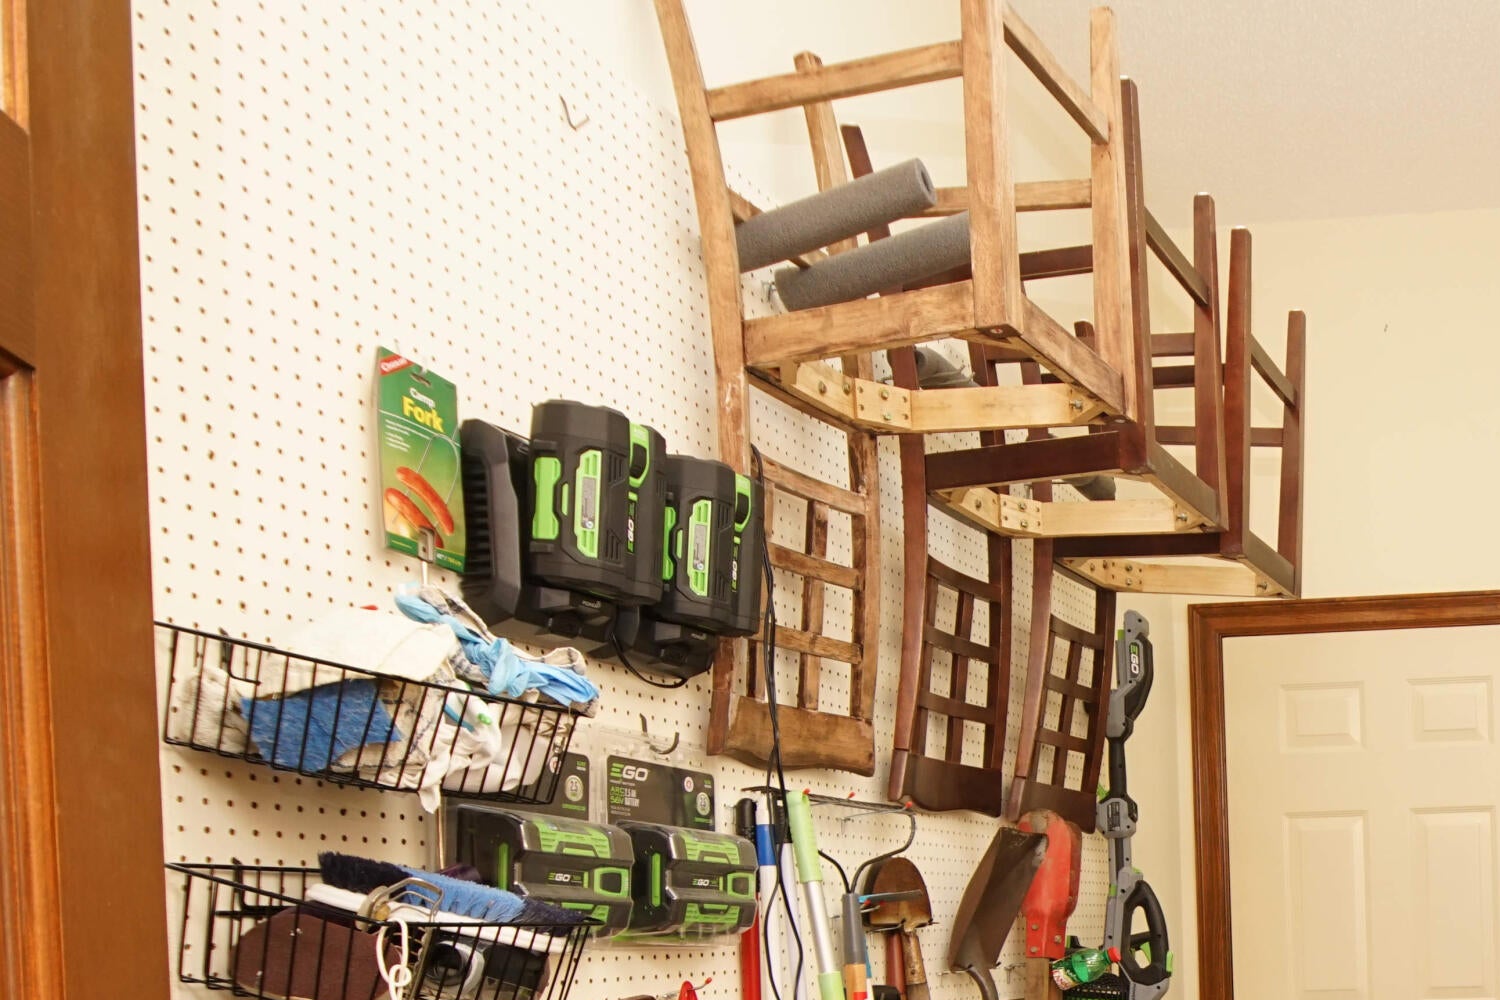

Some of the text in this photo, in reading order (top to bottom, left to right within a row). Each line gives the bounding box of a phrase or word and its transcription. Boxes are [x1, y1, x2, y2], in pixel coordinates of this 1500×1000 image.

[402, 396, 444, 433] Fork
[1129, 642, 1139, 675] EGO
[610, 763, 648, 781] EGO
[548, 872, 571, 882] EGO
